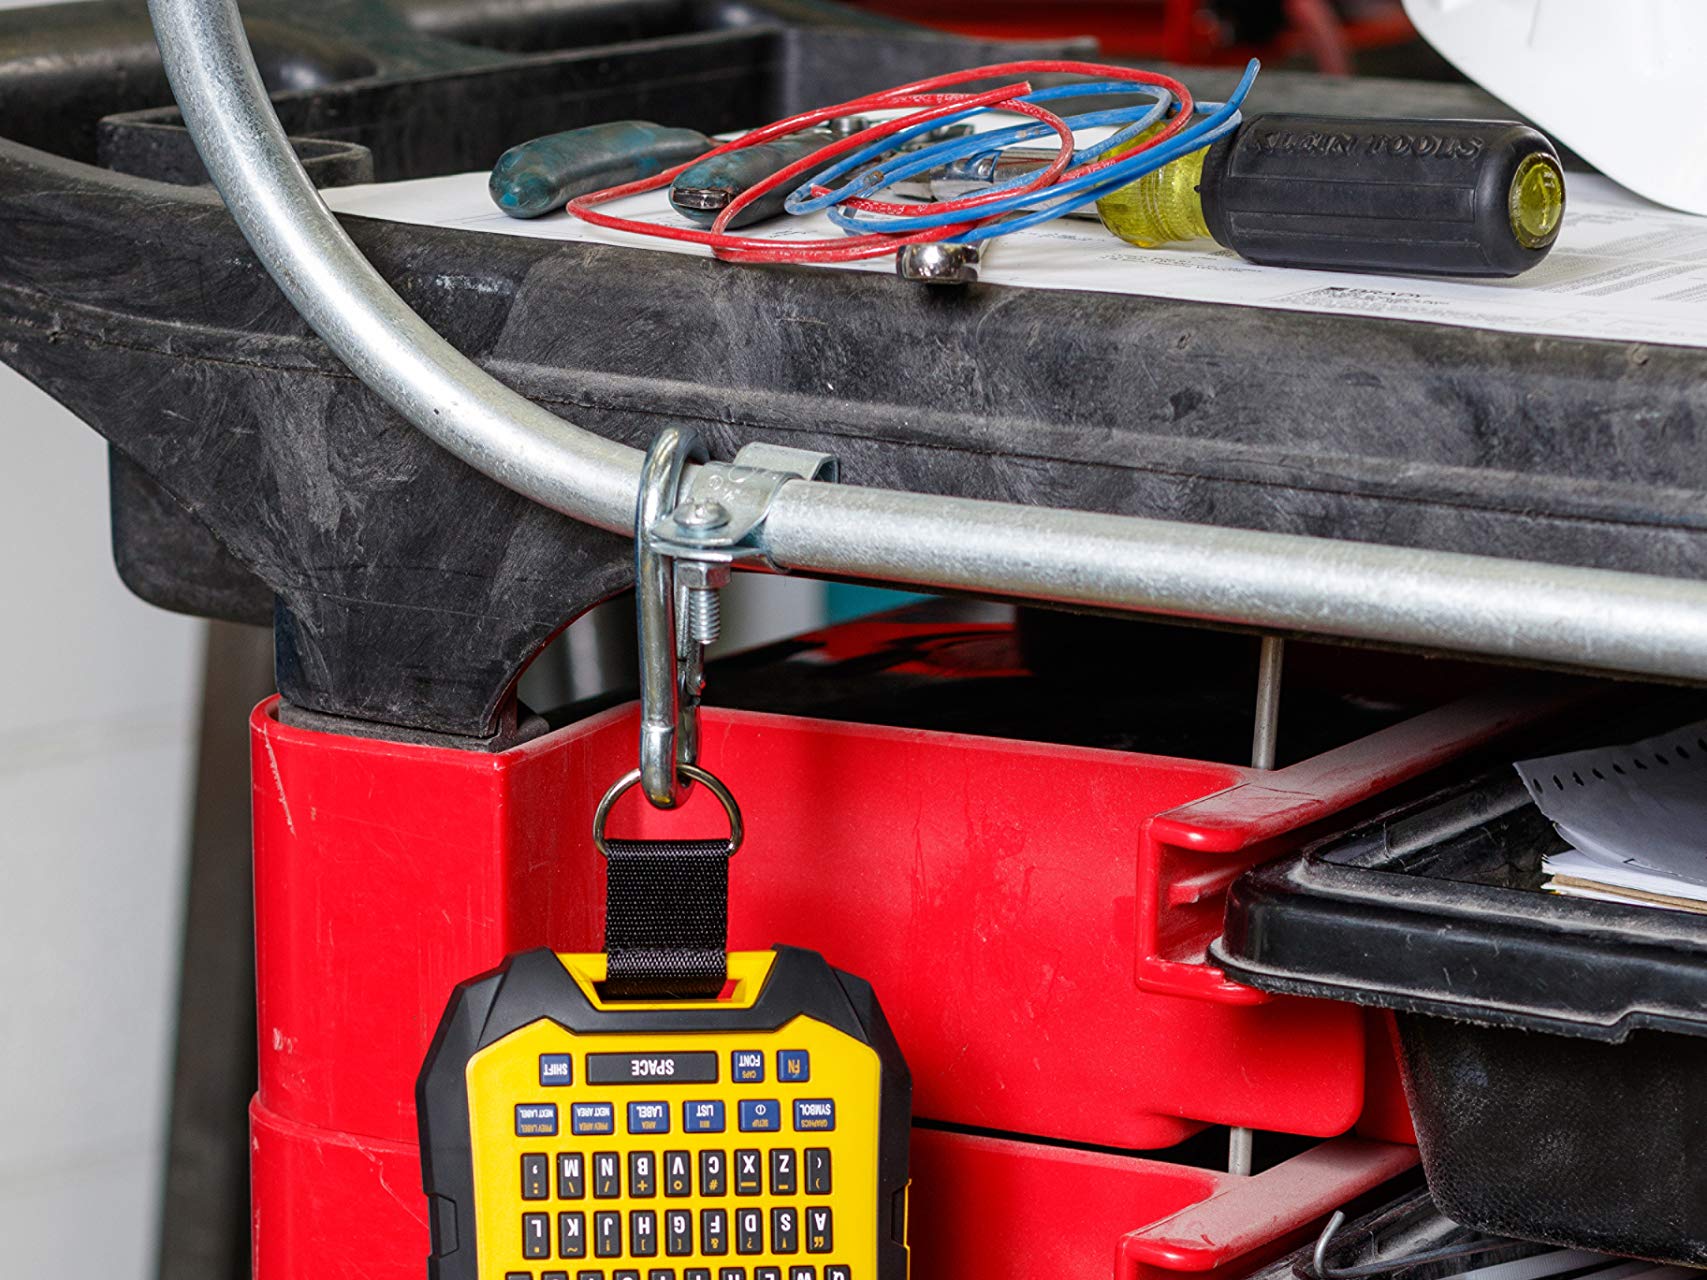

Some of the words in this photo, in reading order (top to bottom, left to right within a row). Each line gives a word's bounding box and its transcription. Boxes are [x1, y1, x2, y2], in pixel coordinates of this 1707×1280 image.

[631, 1059, 674, 1075] SPACE
[739, 1054, 760, 1066] FONT
[787, 1059, 800, 1074] FN
[543, 1063, 567, 1075] SHIFT
[520, 1109, 537, 1118] LABEL
[538, 1109, 553, 1117] NEXT
[594, 1107, 610, 1116] NEXT
[636, 1105, 662, 1117] LABEL
[696, 1104, 714, 1117] LIST
[799, 1104, 831, 1115] SYMBOL
[801, 1119, 827, 1127] GRAPHICS
[564, 1159, 578, 1177] M
[601, 1158, 613, 1176] N
[637, 1158, 648, 1175] B
[672, 1157, 684, 1174] V
[708, 1156, 719, 1173] C
[743, 1155, 755, 1173] X
[779, 1155, 789, 1172] Z
[531, 1219, 541, 1237] L
[567, 1218, 578, 1236] K
[604, 1218, 613, 1235] J
[638, 1216, 650, 1234] H
[673, 1216, 685, 1233] G
[710, 1215, 720, 1233] F
[744, 1214, 756, 1232] D
[780, 1213, 791, 1231] S
[814, 1213, 826, 1230] A
